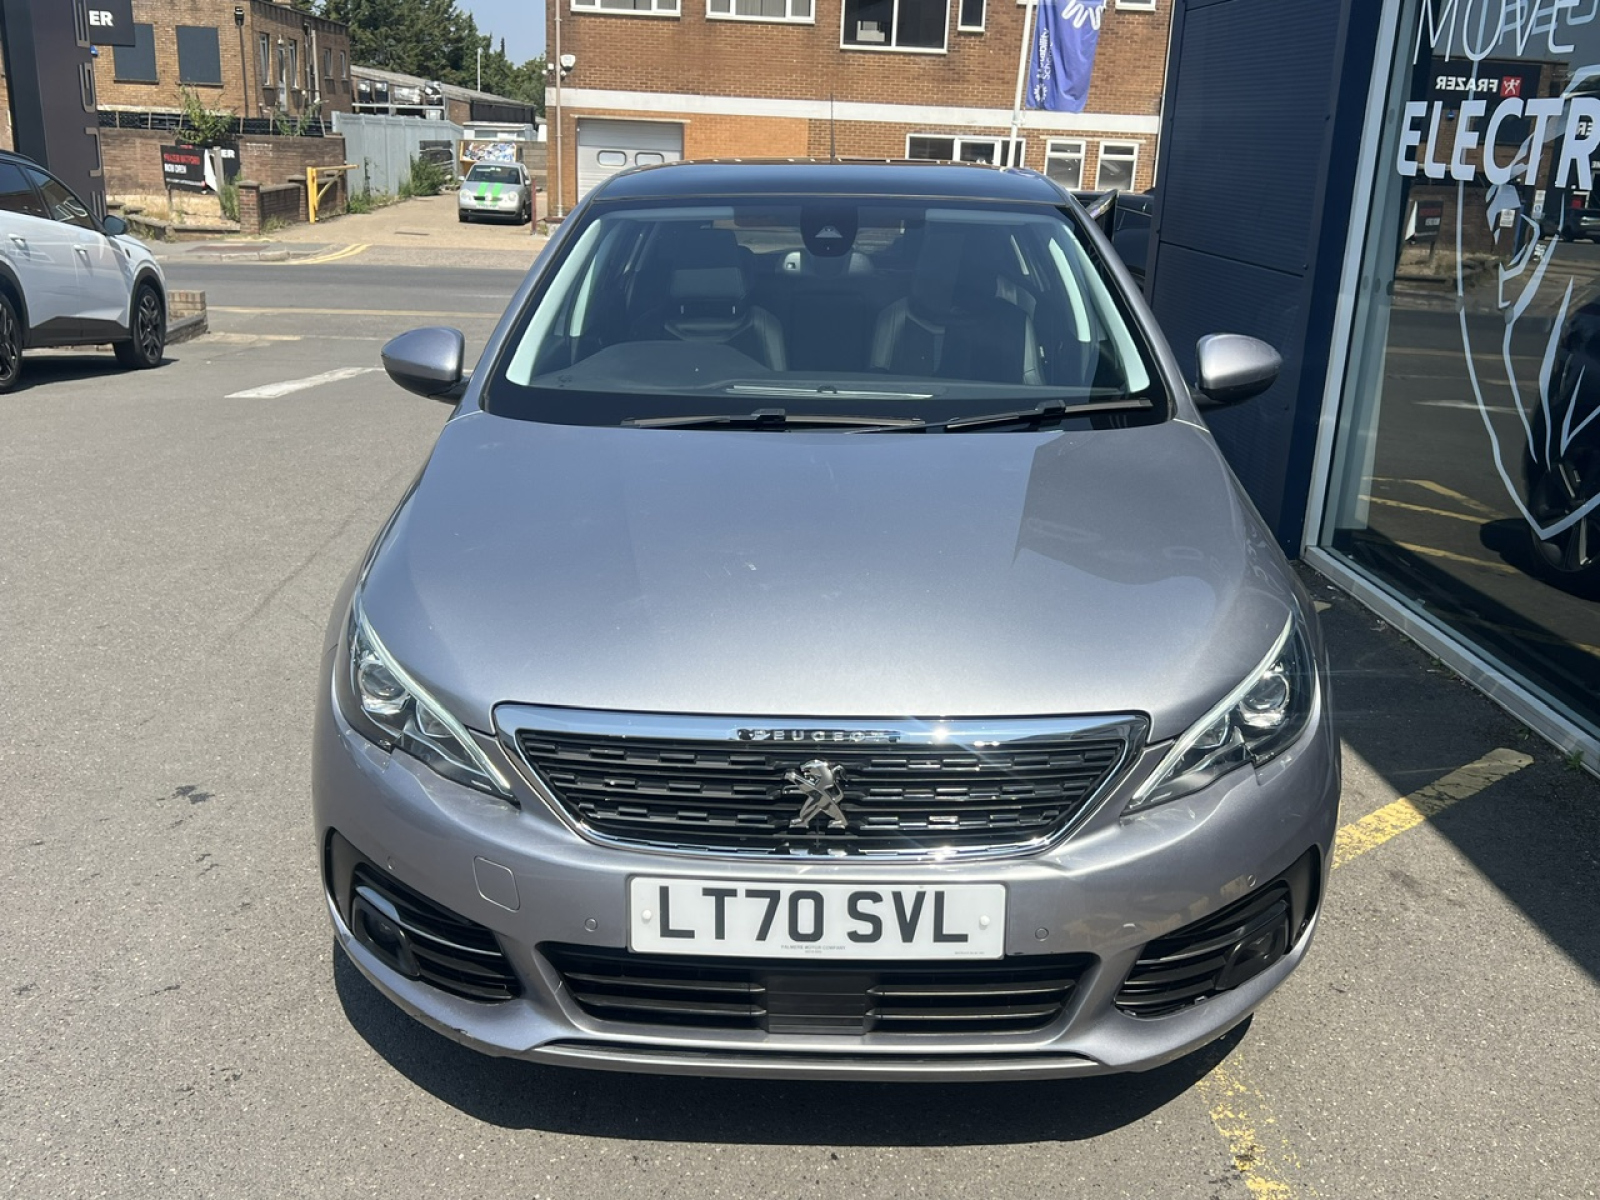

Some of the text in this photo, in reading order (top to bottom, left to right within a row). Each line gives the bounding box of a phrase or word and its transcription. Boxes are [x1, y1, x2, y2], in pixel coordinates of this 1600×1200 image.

[751, 729, 885, 742] PEUGEOT
[659, 885, 969, 943] LT70 SVL
